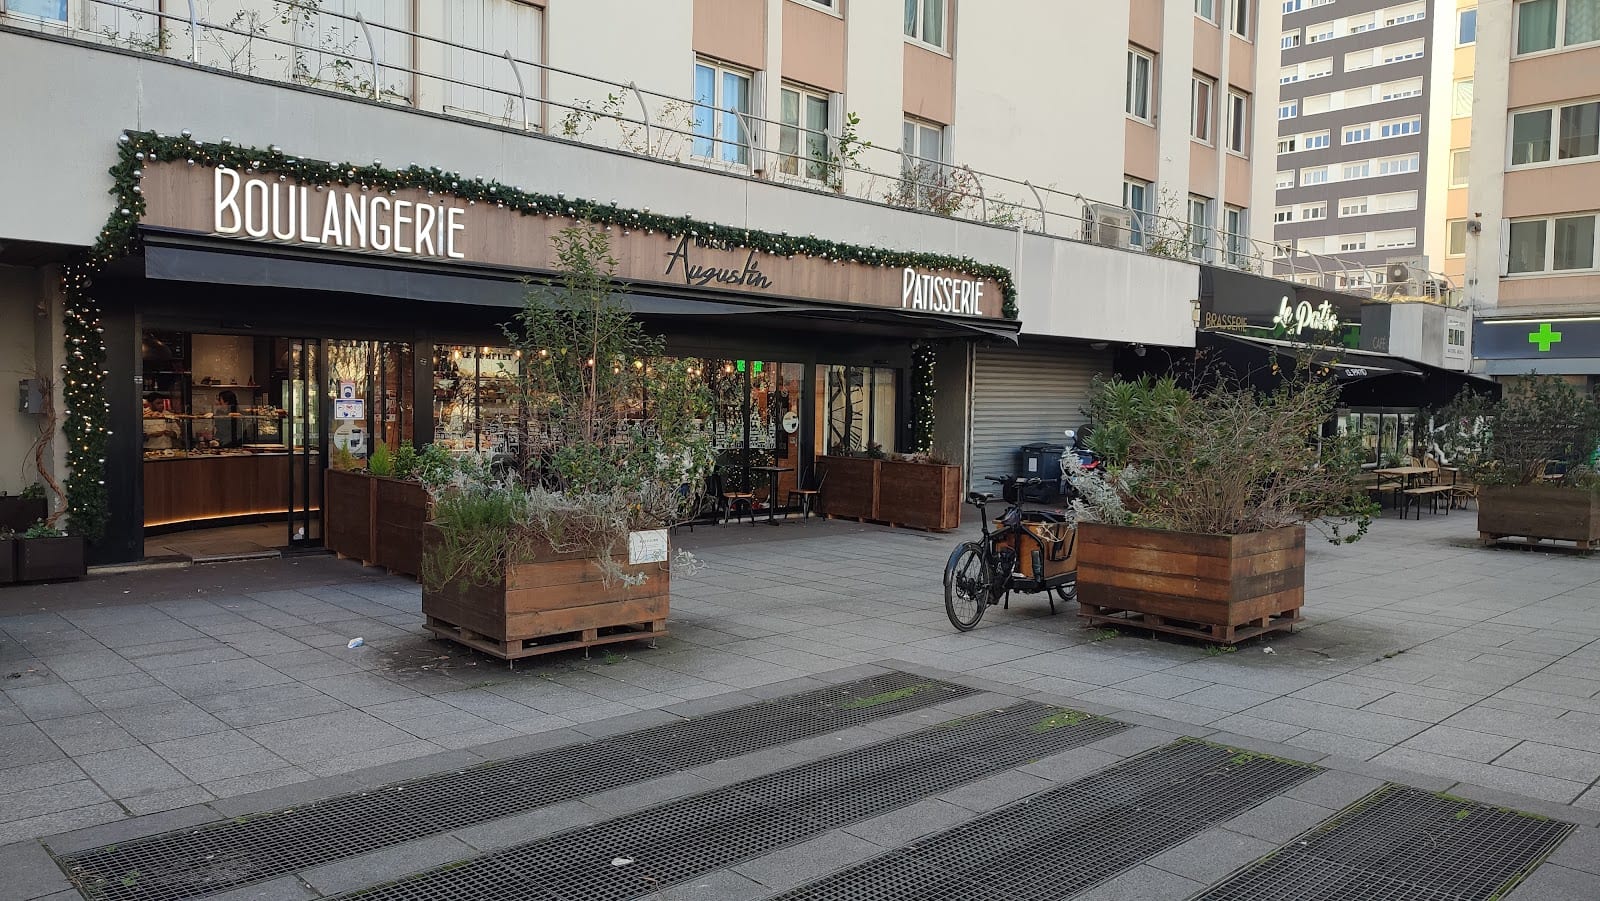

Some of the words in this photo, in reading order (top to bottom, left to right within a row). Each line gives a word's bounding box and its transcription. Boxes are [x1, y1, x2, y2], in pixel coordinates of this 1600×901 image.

[214, 167, 465, 259] BOULANGERIE
[665, 234, 773, 289] Augustin
[902, 267, 984, 316] PATISSERIE
[1204, 311, 1249, 333] BRASSERIE
